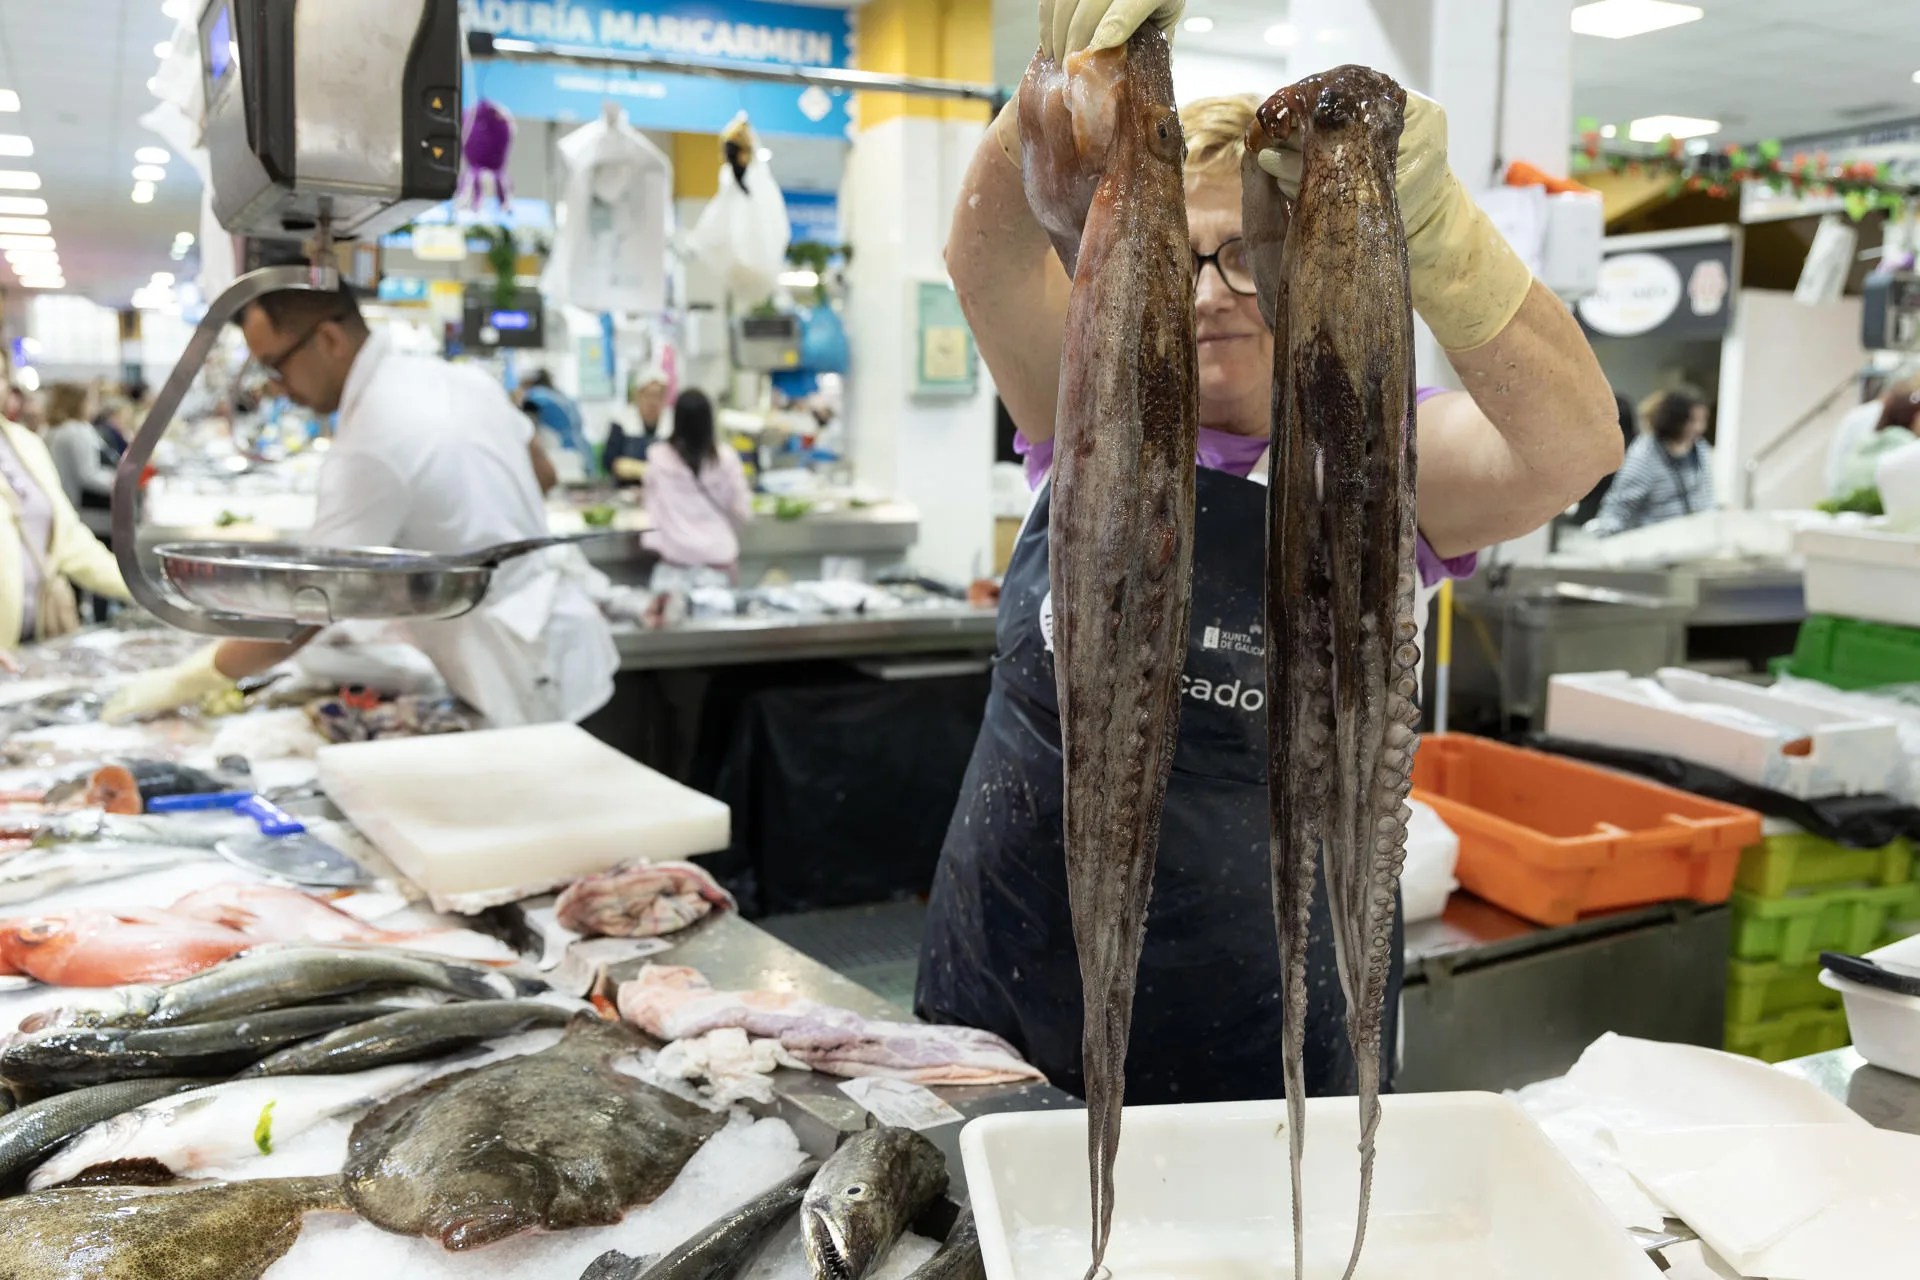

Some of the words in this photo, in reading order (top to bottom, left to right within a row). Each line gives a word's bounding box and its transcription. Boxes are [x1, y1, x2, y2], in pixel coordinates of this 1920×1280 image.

[600, 9, 831, 65] MARICARMEN
[1220, 640, 1233, 650] DE
[1221, 631, 1252, 645] XUNTA
